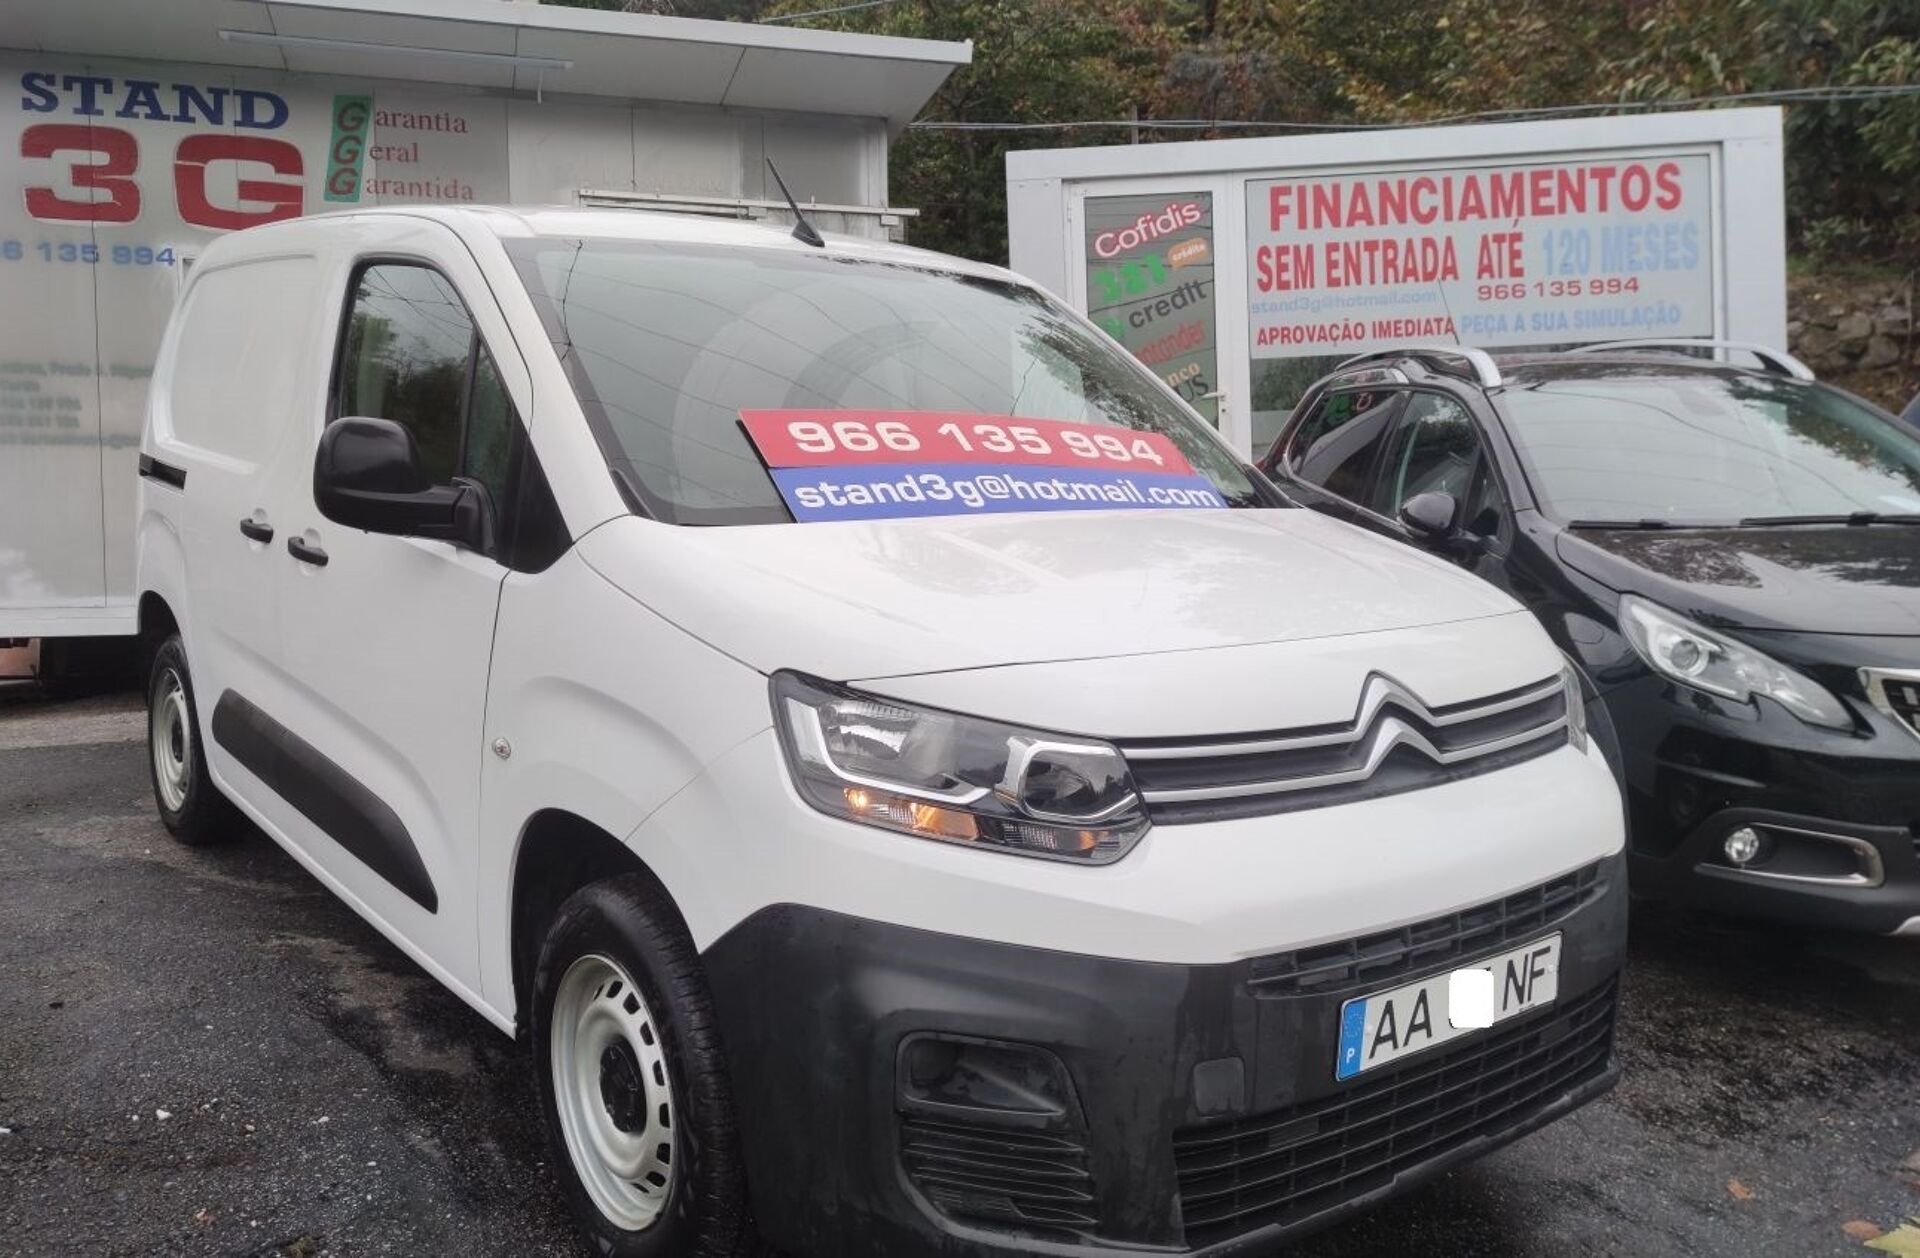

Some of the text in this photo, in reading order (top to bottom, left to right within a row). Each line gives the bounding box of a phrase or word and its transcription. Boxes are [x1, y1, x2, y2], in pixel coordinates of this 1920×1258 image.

[21, 72, 289, 130] STAND
[20, 123, 304, 231] 3G
[1269, 162, 1682, 231] FINANCIAMENTOS
[37, 241, 99, 264] 135
[1095, 202, 1201, 258] Cofidis
[1256, 219, 1699, 292] SEM ENTRADA ATÉ 120 MESES
[1129, 280, 1207, 329] credit
[1477, 277, 1640, 300] 966 135 994
[1257, 317, 1456, 347] APROVAÇÃO IMEDIATA
[1461, 302, 1682, 337] PEÇA A SUA SIMULAÇÃO
[788, 421, 1163, 466] 966 135 994
[795, 472, 1221, 509] stand3g@hotmail.com
[1368, 946, 1551, 1060] AA NF
